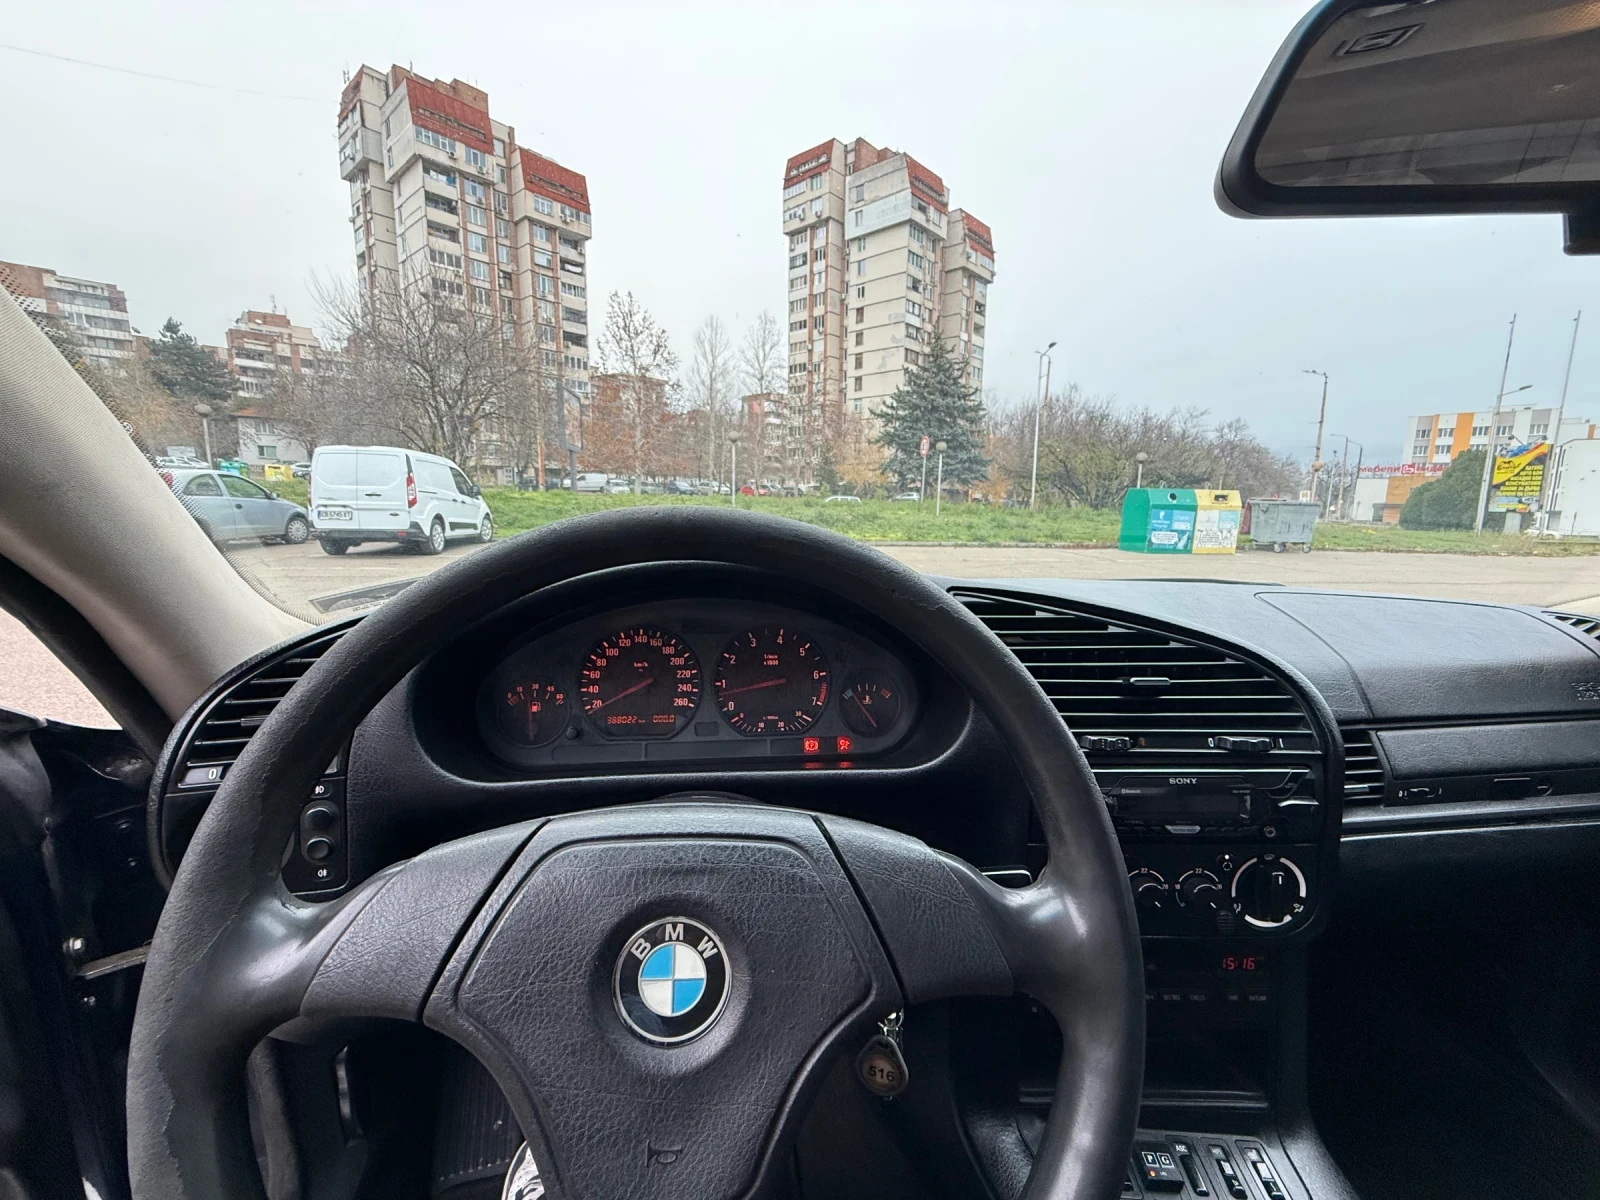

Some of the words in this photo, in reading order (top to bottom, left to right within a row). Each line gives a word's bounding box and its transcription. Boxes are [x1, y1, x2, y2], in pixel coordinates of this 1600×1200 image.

[619, 639, 631, 647] 120
[634, 635, 648, 643] 140
[649, 638, 663, 646] 160
[750, 638, 757, 648] 3
[776, 636, 784, 645] 4
[605, 648, 619, 657] 100
[662, 646, 675, 655] 180
[799, 647, 806, 657] 5
[596, 658, 607, 667] 80
[670, 657, 685, 666] 200
[729, 655, 736, 664] 2
[590, 670, 600, 679] 60
[676, 669, 691, 678] 220
[813, 670, 819, 680] 6
[677, 683, 692, 692] 240
[721, 679, 726, 689] 1
[588, 685, 599, 694] 40
[592, 699, 603, 709] 20
[673, 698, 689, 707] 260
[728, 701, 735, 711] 0
[811, 697, 817, 706] 7
[1169, 777, 1198, 785] SONY
[630, 924, 719, 960] BMW
[868, 1066, 895, 1082] 516
